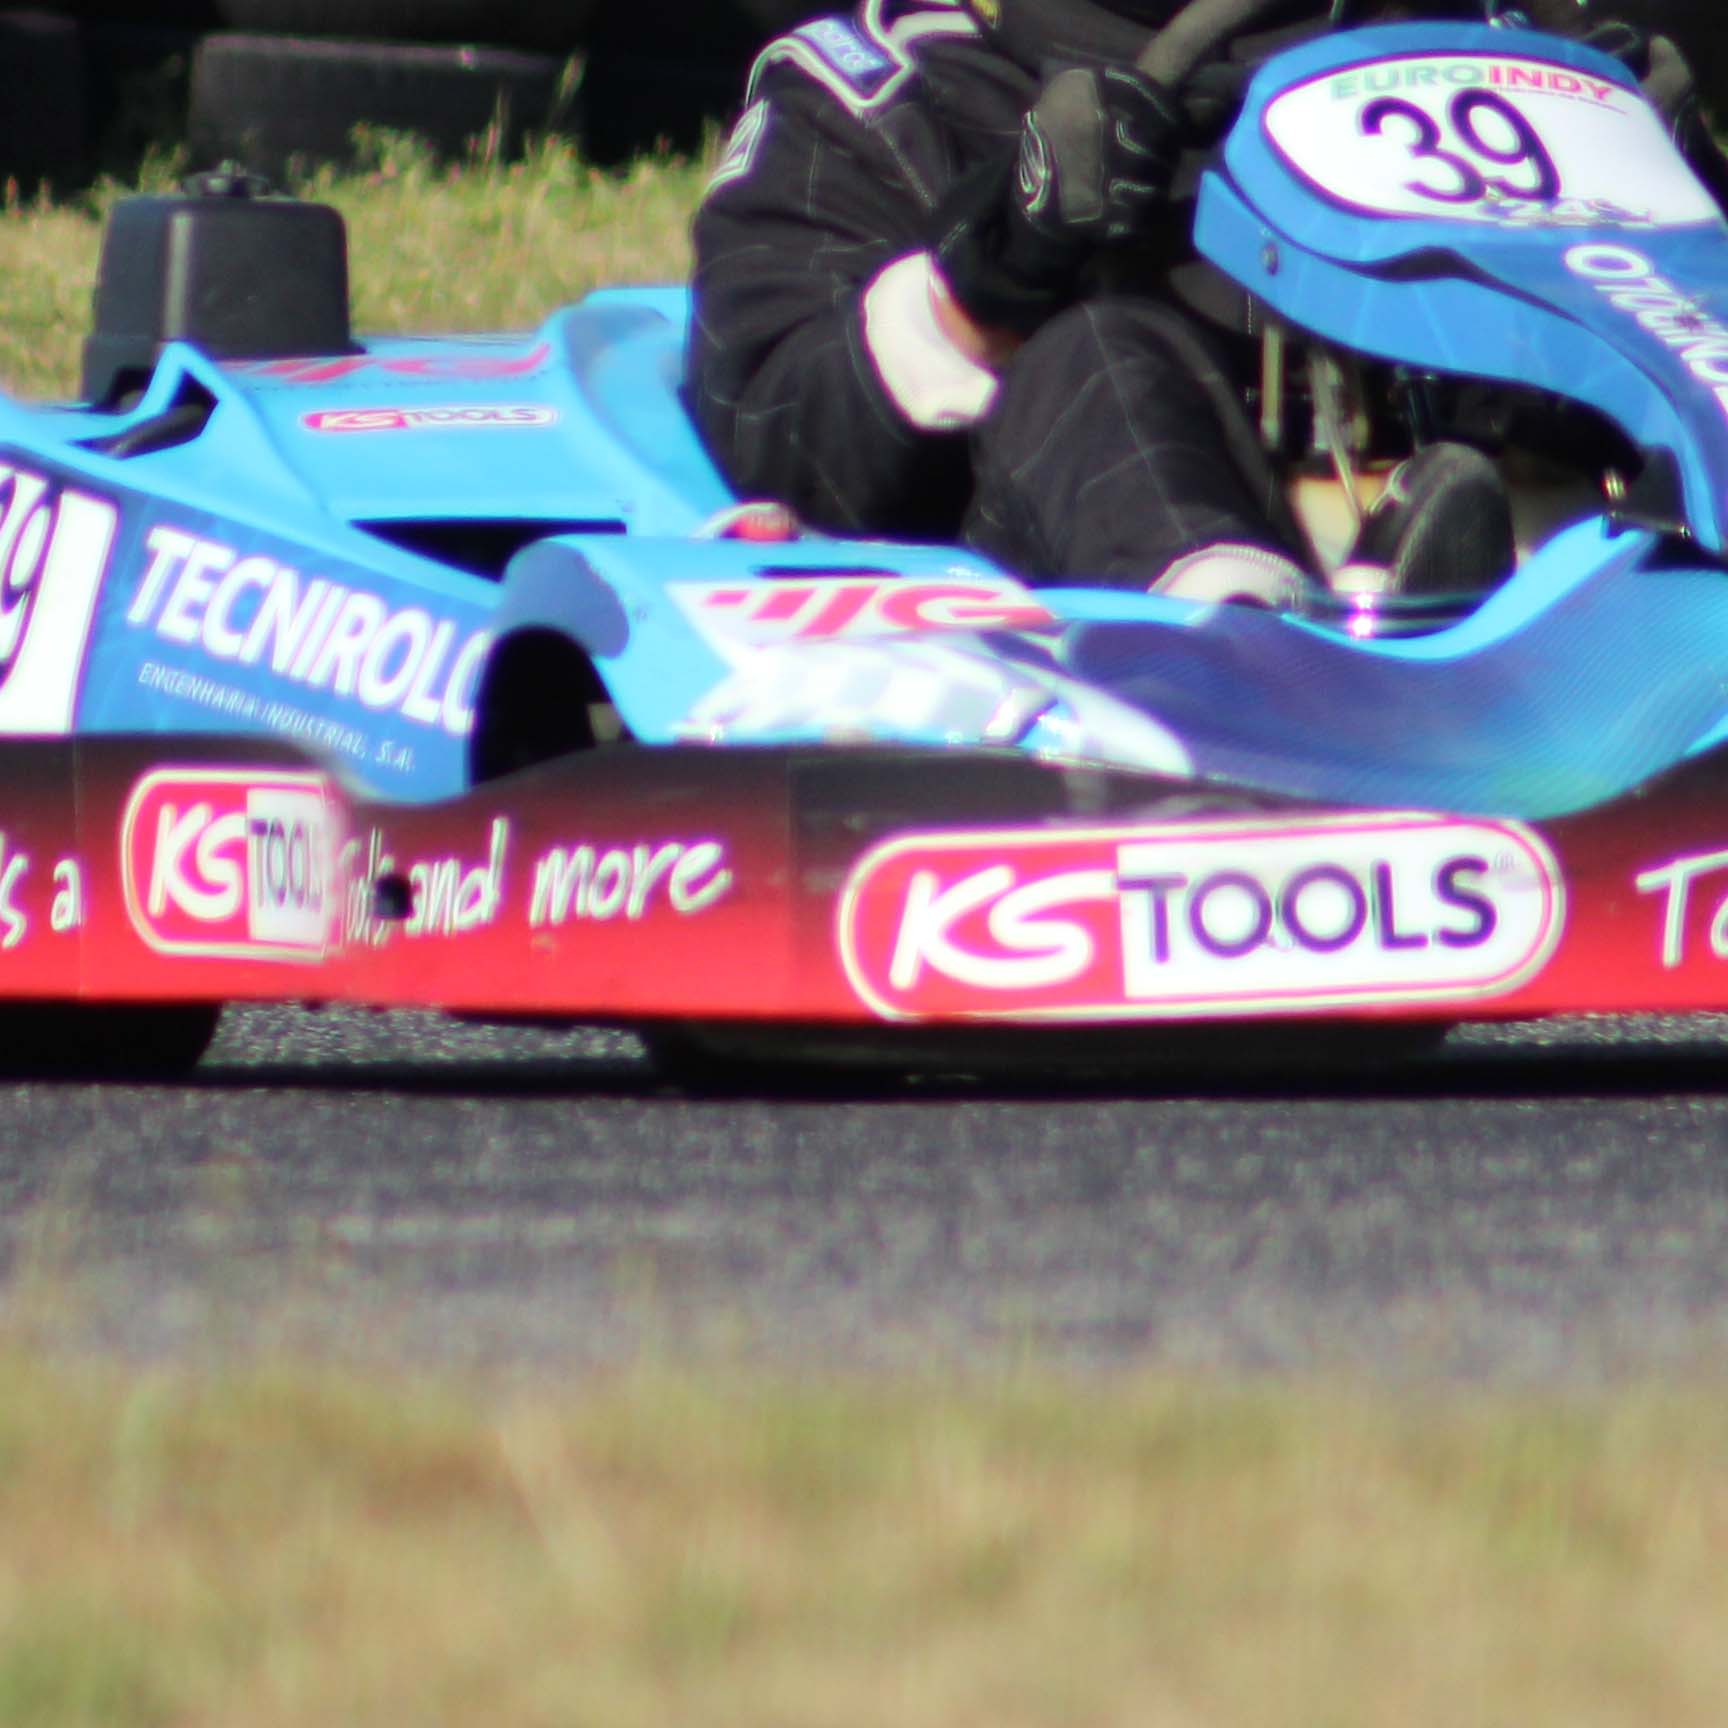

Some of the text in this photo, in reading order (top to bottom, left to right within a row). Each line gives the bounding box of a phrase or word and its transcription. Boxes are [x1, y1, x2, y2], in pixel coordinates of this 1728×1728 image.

[1330, 64, 1612, 100] EUROINDY
[1357, 87, 1562, 204] 39
[148, 801, 248, 920] KS
[405, 815, 509, 939] and
[529, 836, 734, 930] more
[888, 856, 1498, 991] KS TOOLS
